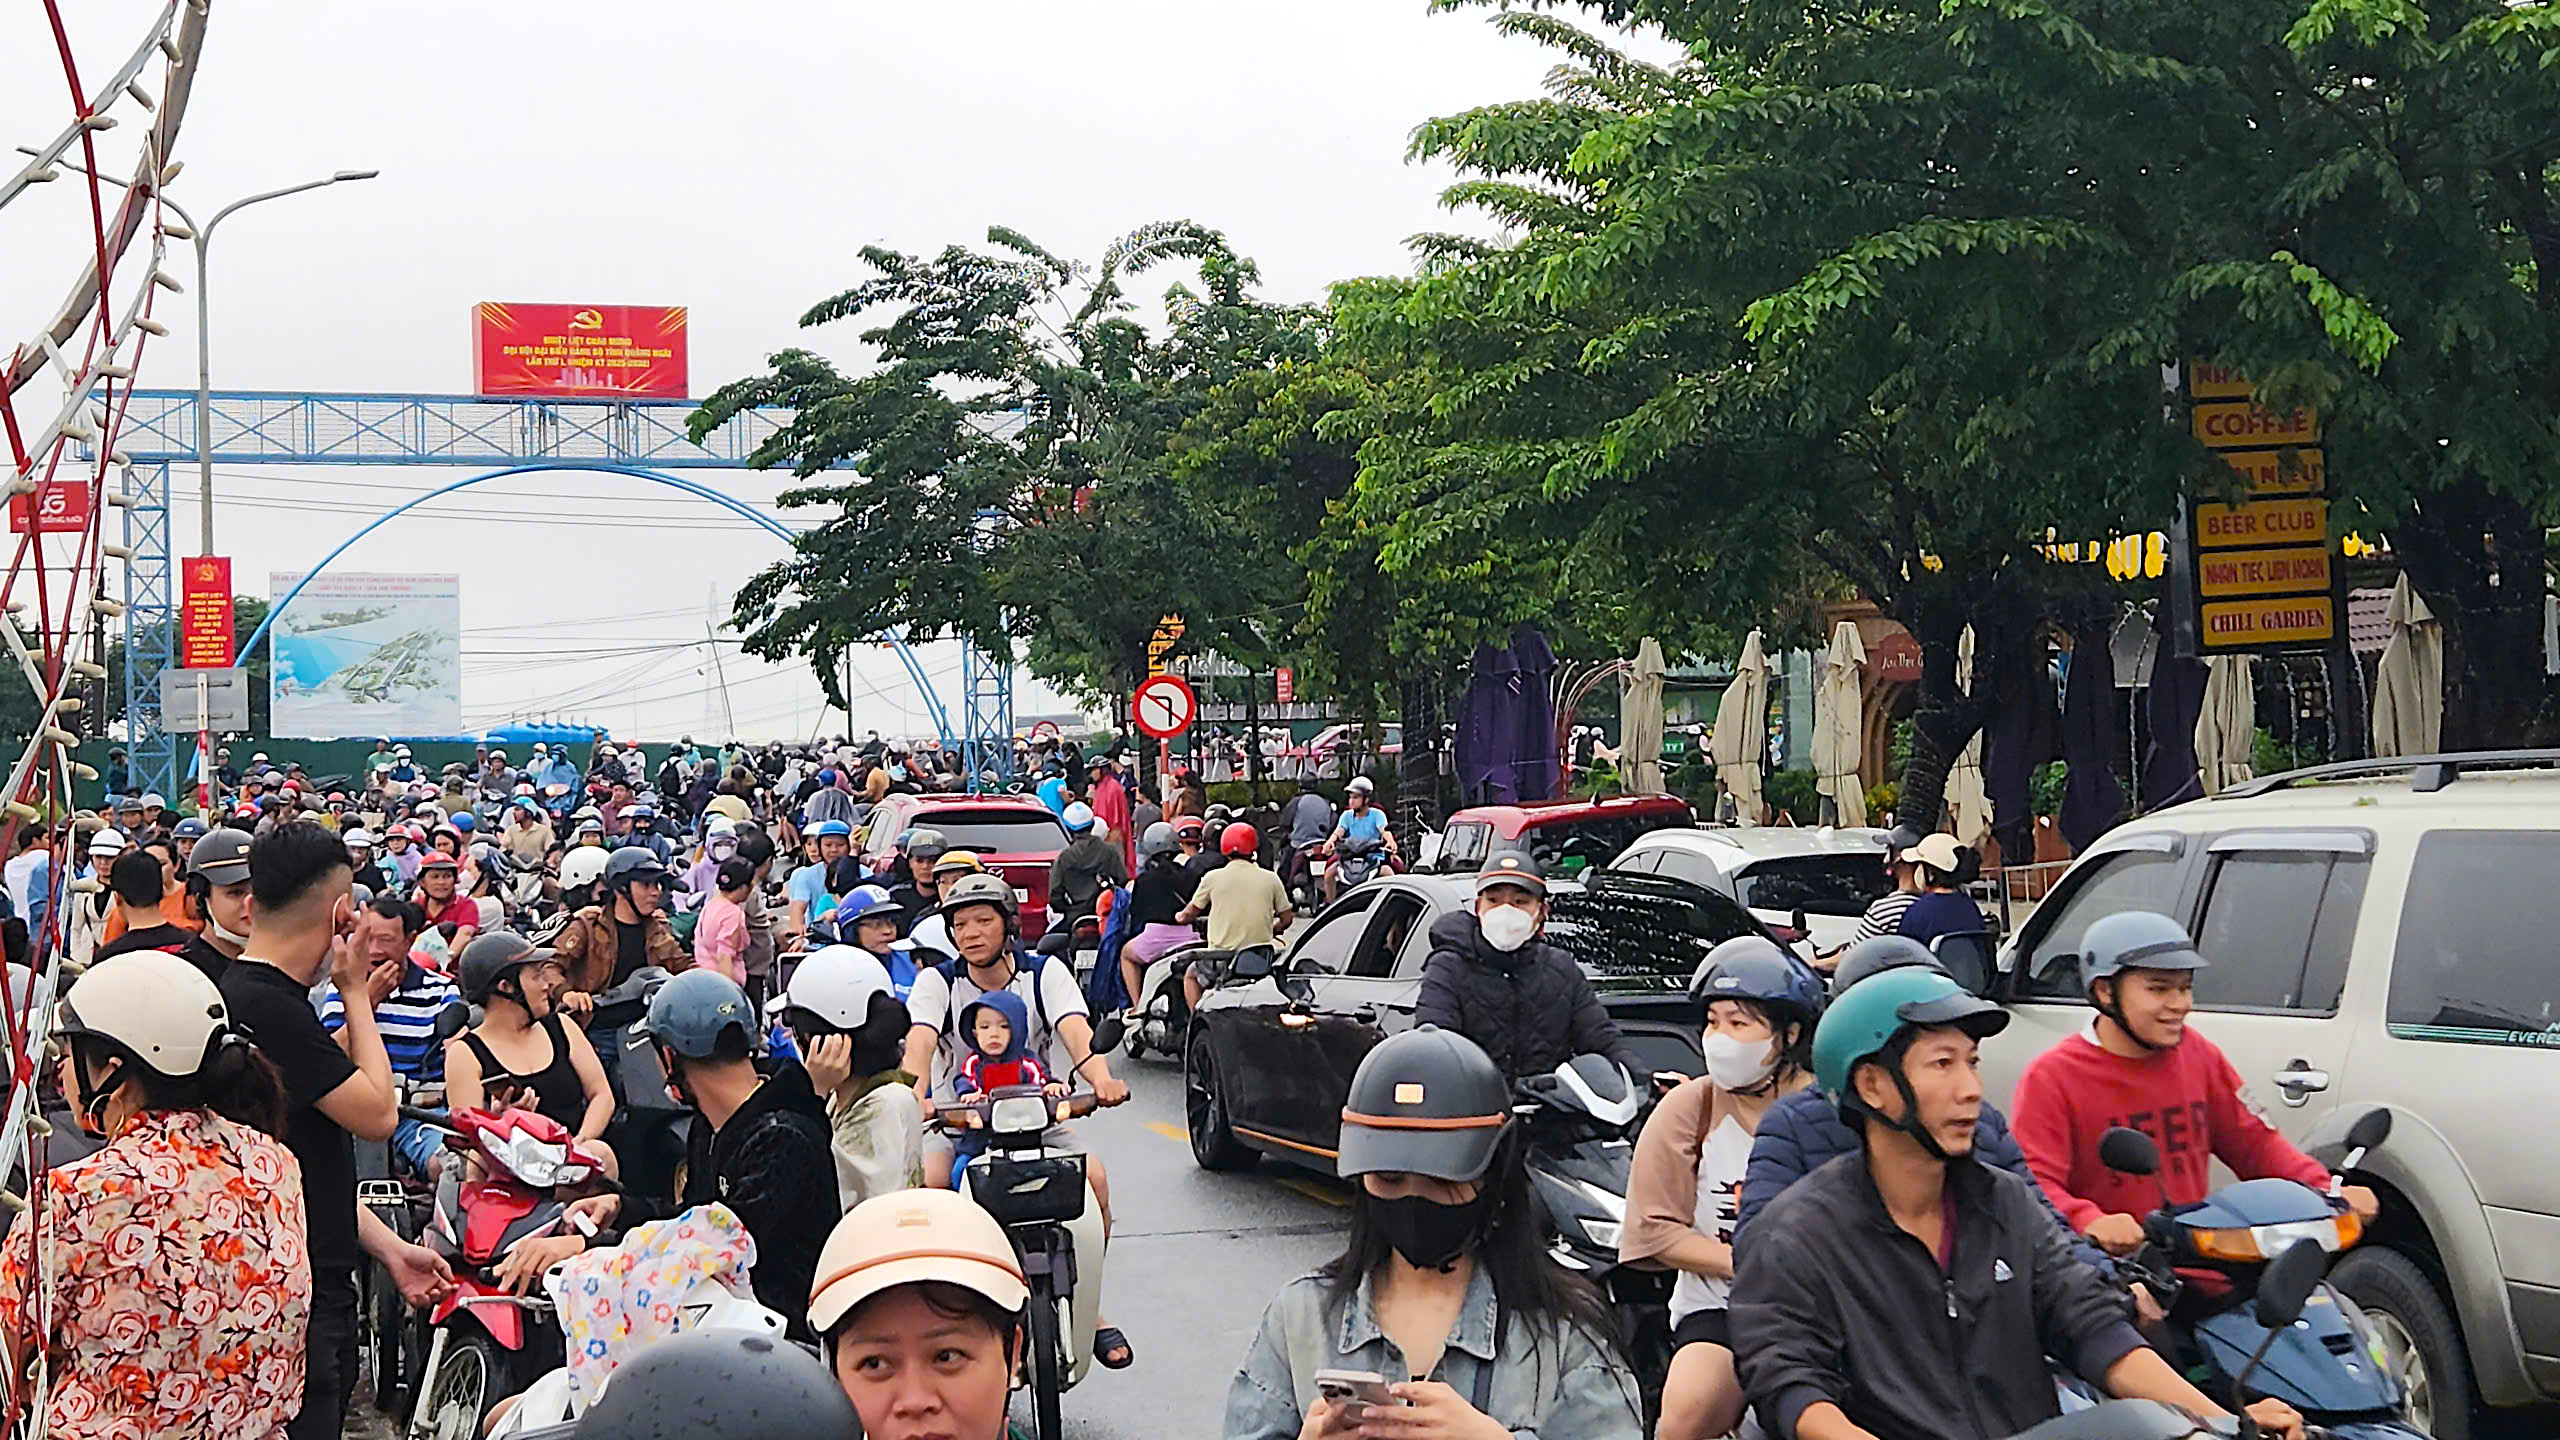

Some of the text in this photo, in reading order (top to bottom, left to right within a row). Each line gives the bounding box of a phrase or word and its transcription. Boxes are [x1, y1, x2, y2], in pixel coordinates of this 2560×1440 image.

[2207, 511, 2316, 535] BEER CLUB
[2211, 608, 2325, 633] CHILL GARDEN
